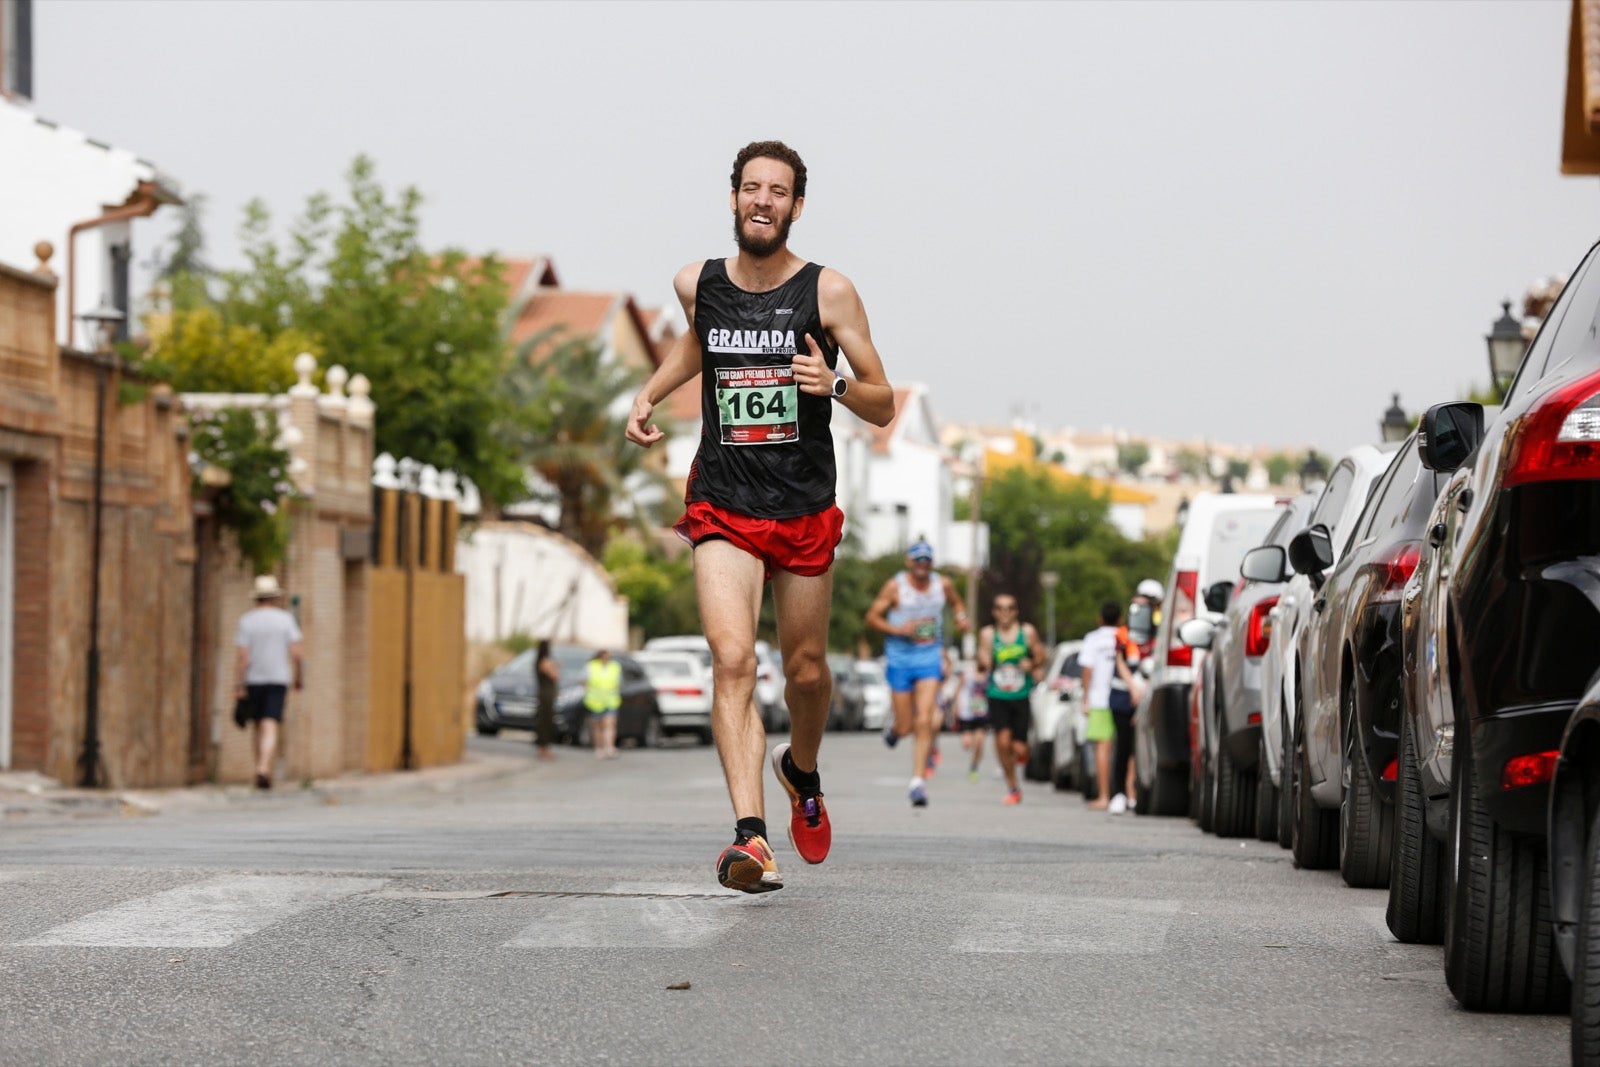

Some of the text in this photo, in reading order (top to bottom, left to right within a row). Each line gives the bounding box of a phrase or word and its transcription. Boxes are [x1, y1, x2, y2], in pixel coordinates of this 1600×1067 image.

[708, 328, 796, 348] GRANADA
[730, 370, 744, 379] GRAN
[745, 369, 765, 379] PREMIO
[766, 369, 773, 378] DE
[774, 368, 792, 378] FONDO
[728, 391, 786, 419] 164
